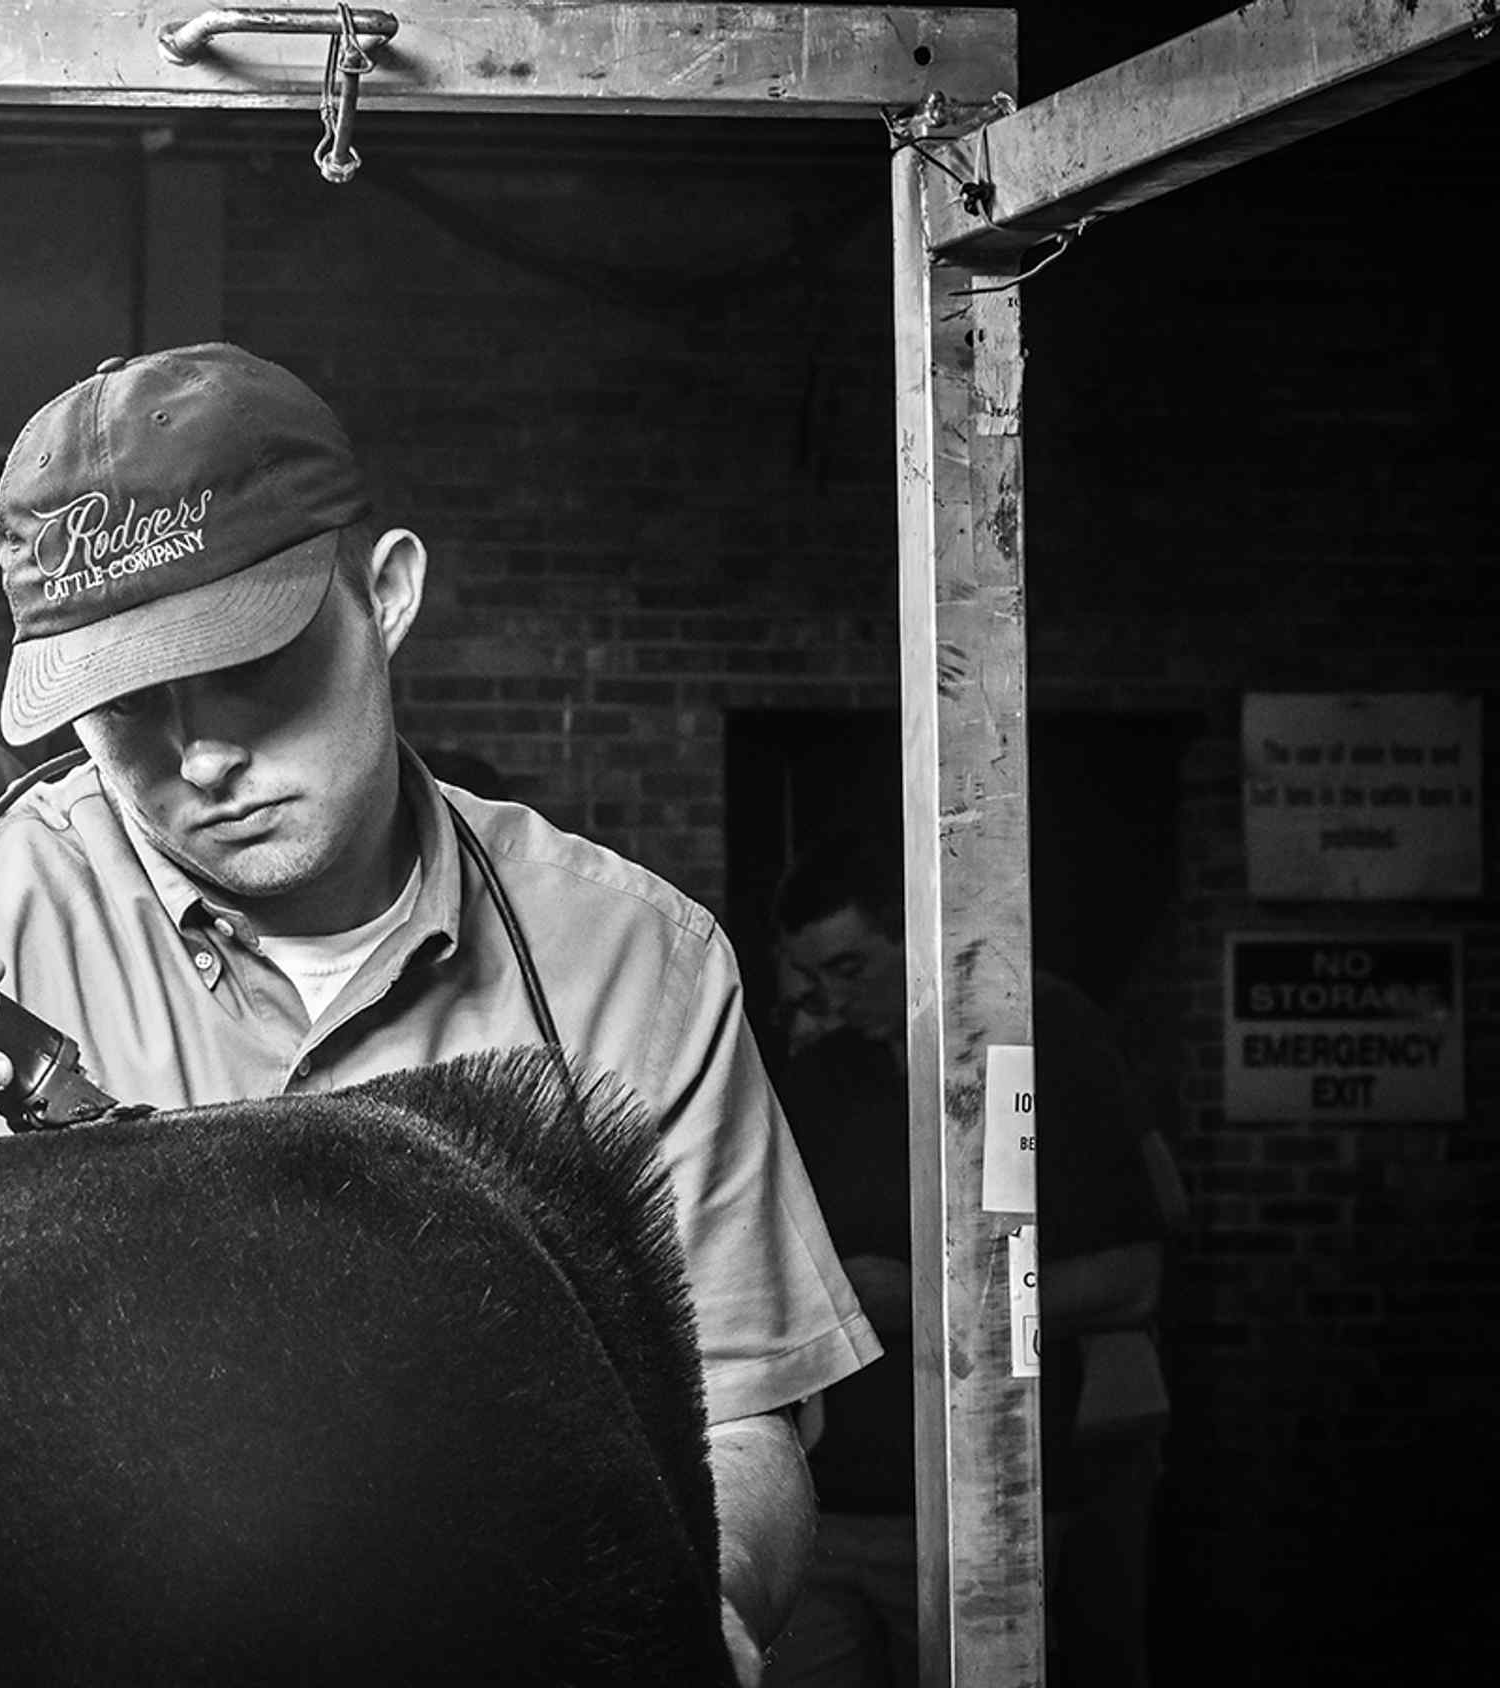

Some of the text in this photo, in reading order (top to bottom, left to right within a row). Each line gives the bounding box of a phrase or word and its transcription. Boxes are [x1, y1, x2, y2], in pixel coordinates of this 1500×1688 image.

[31, 489, 213, 579] Rodgers
[43, 529, 205, 603] CATTLE COMPANY
[1313, 950, 1373, 978] NO
[1241, 1034, 1445, 1069] EMERGENCY
[1014, 1092, 1036, 1113] IO
[1312, 1075, 1377, 1108] EXIT
